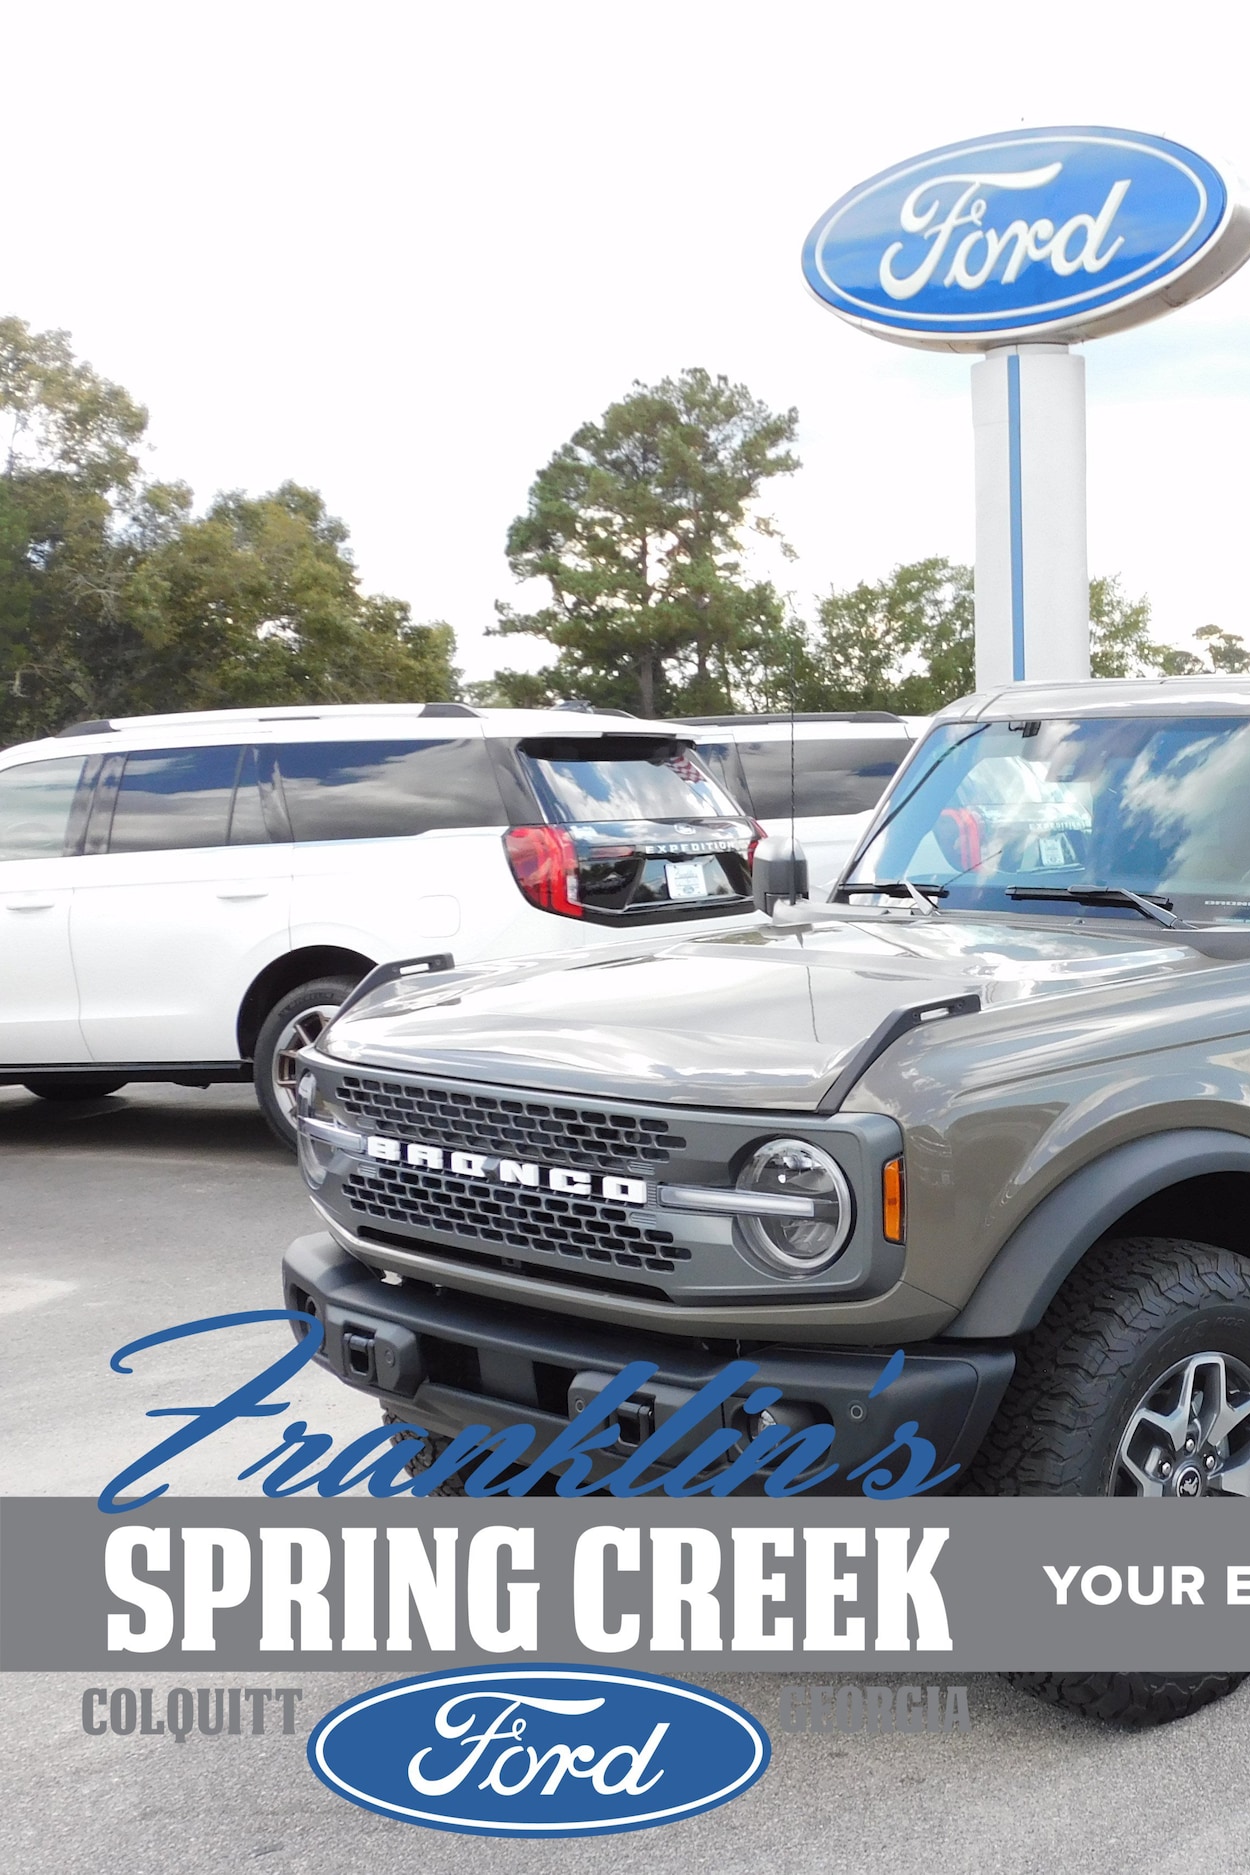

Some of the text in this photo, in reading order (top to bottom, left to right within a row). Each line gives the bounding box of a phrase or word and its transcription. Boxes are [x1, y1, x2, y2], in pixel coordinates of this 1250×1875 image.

[880, 161, 1132, 300] Ford
[645, 841, 734, 854] EXPEDITION
[367, 1135, 647, 1205] BRONCO
